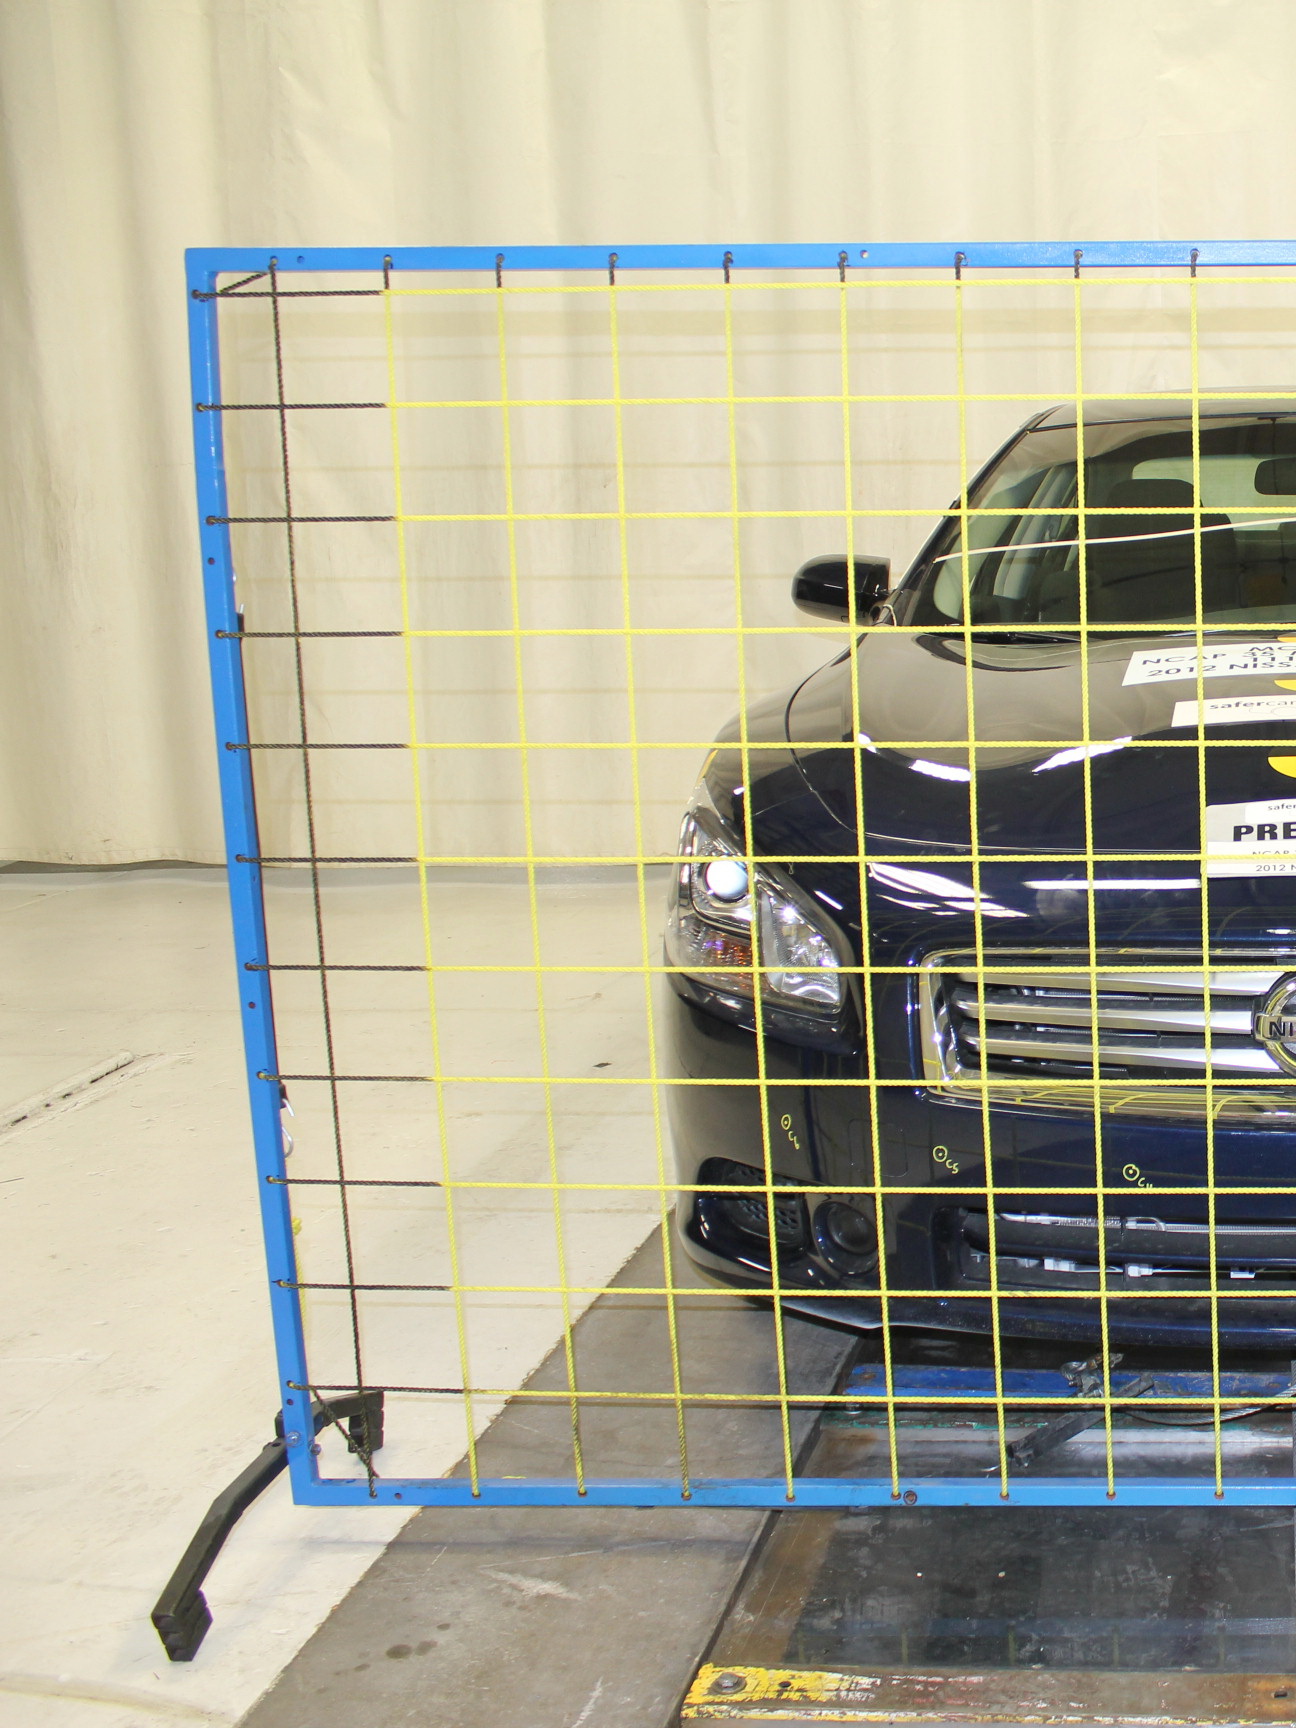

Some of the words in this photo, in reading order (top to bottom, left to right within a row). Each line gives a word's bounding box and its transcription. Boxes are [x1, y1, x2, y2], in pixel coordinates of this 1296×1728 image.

[1142, 653, 1228, 665] NCAP
[1148, 665, 1217, 677] 2012
[1255, 864, 1286, 872] 2012
